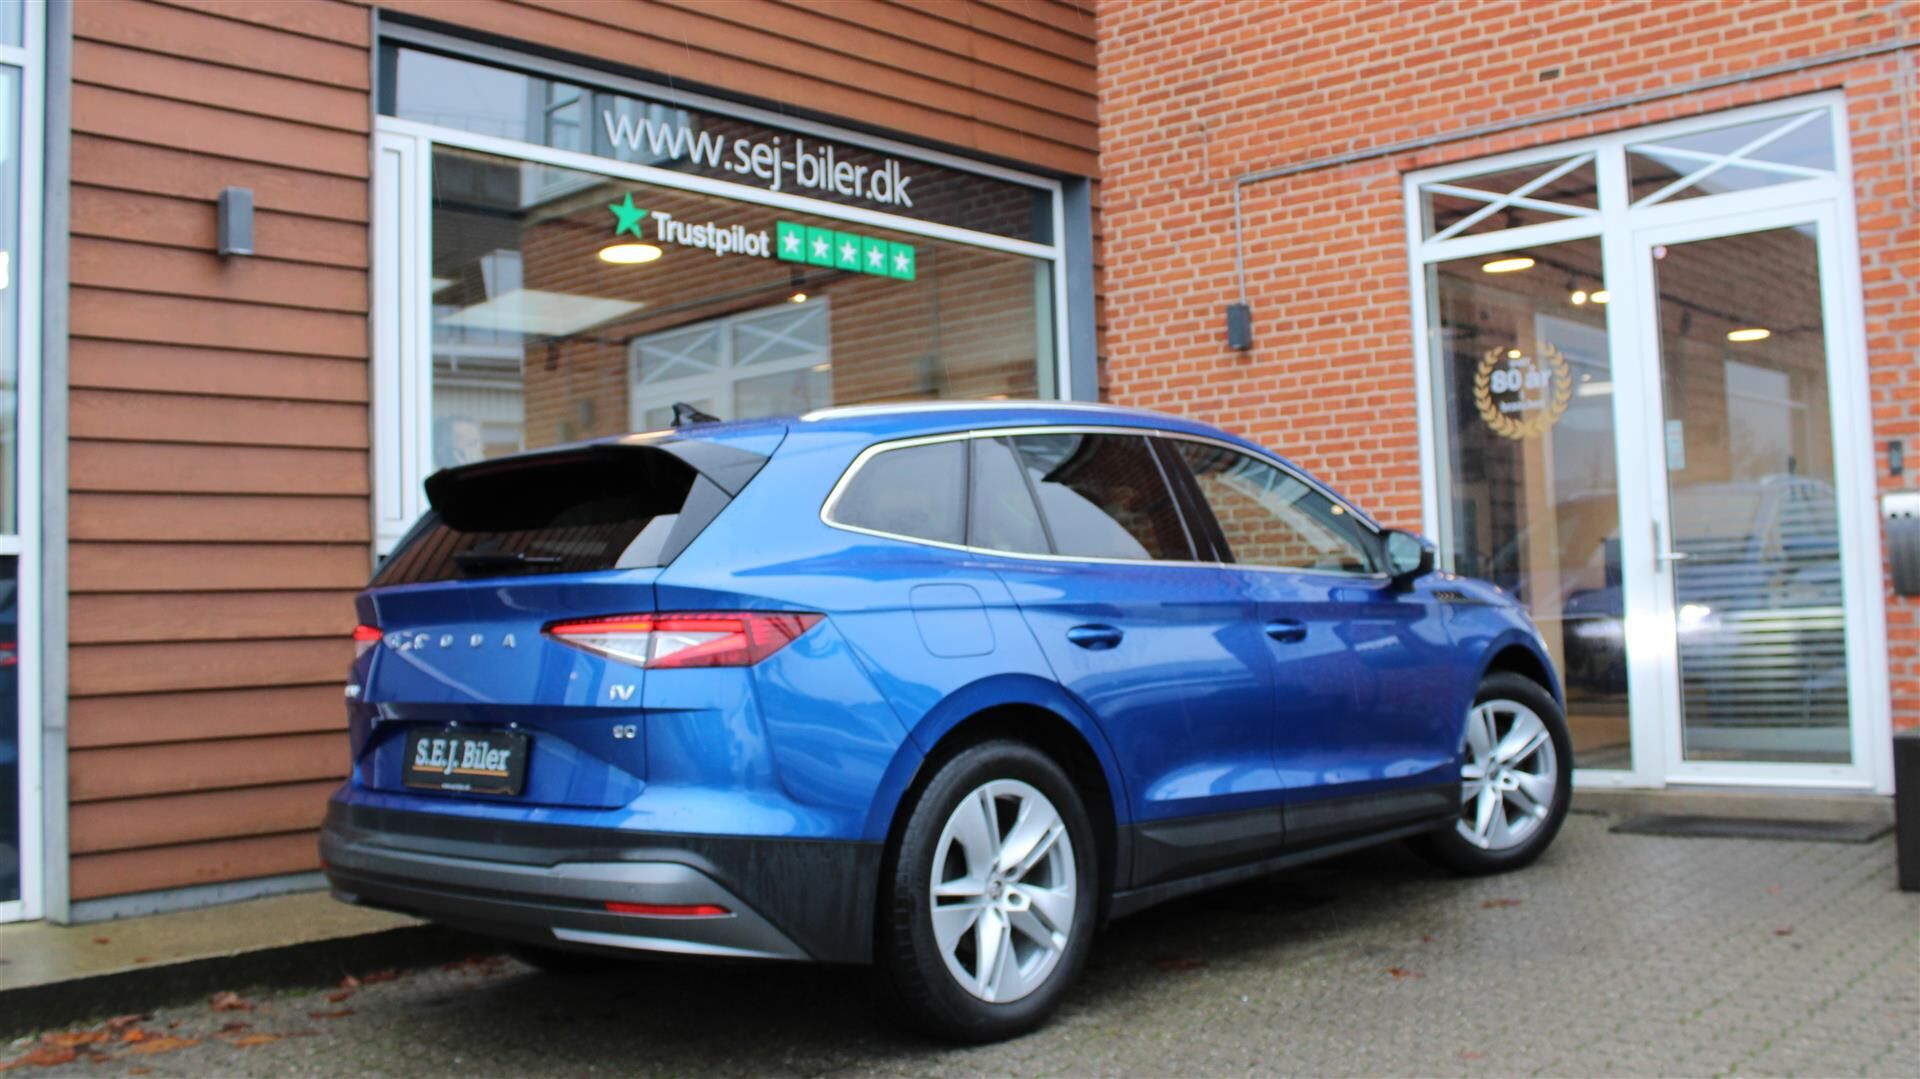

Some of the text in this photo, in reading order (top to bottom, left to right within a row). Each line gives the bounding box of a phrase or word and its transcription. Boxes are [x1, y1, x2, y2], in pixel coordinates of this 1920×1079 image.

[603, 110, 913, 207] www.sej-biler.dk
[652, 211, 770, 257] Trustpilot
[1491, 369, 1521, 393] 80
[415, 738, 511, 775] S.E.J. Biler
